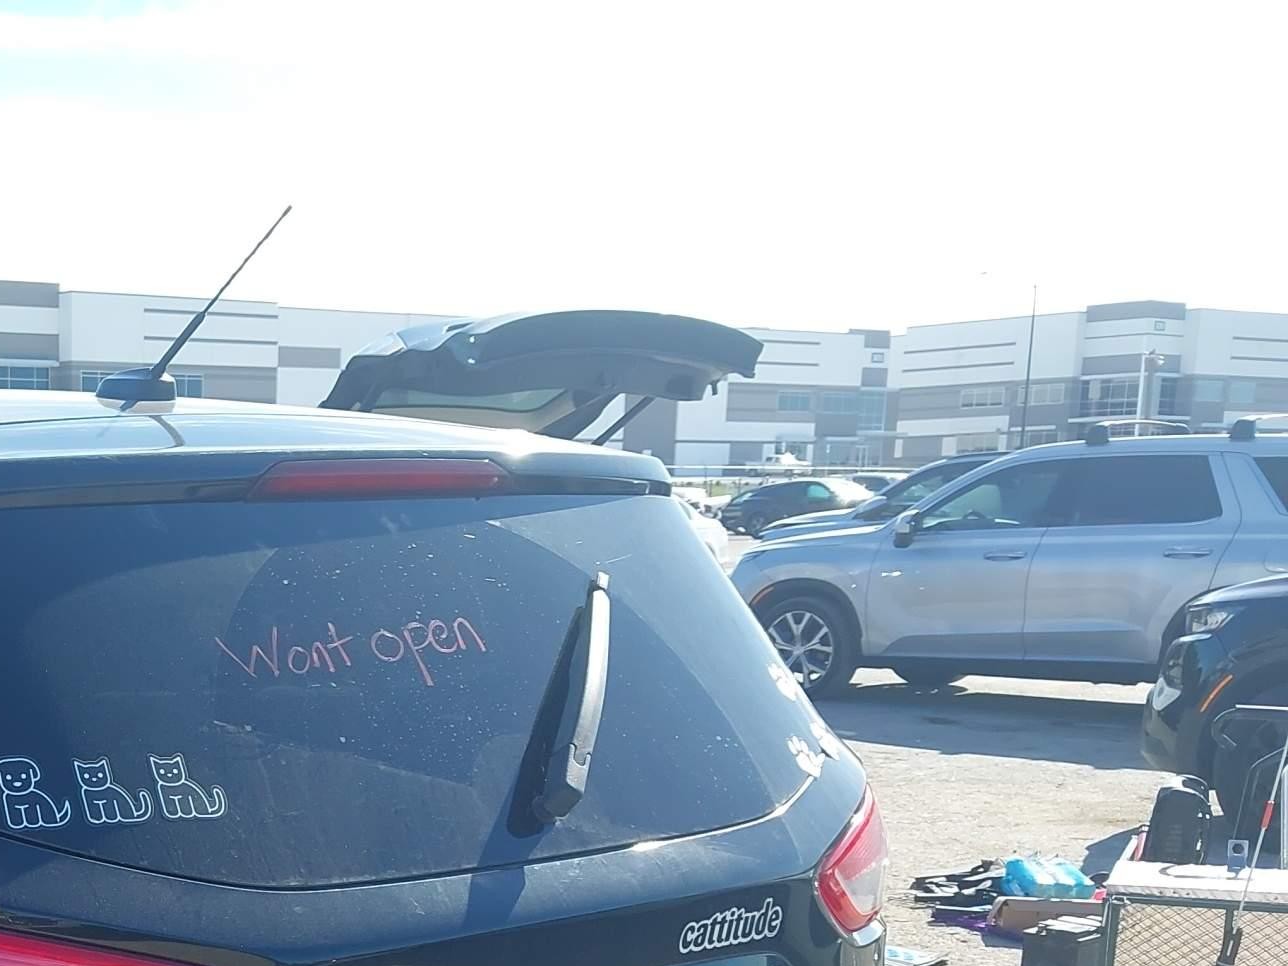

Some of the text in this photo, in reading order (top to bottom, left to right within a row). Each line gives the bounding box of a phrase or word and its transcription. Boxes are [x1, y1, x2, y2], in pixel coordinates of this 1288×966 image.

[215, 617, 487, 686] Wont open
[680, 898, 782, 953] cattitude
